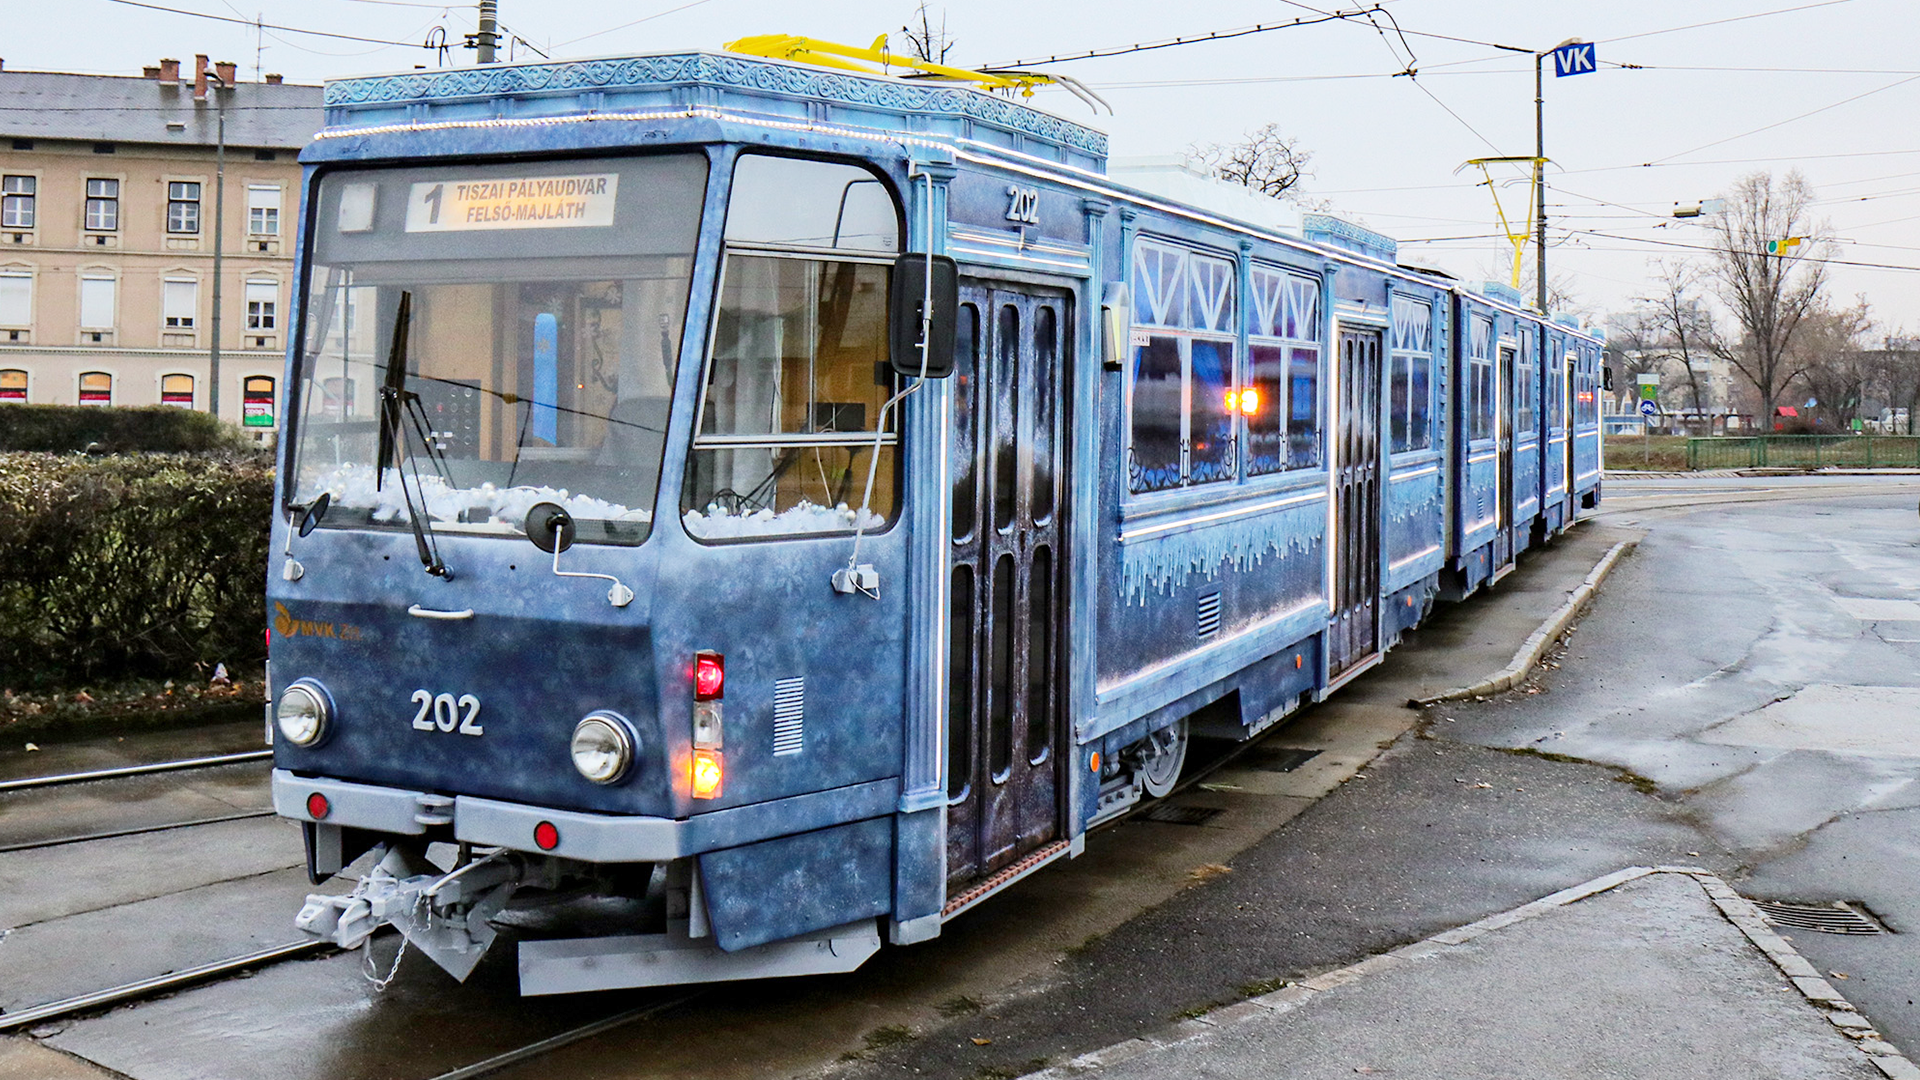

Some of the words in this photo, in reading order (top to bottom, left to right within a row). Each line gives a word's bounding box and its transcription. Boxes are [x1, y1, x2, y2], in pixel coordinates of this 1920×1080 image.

[1556, 45, 1594, 73] VK
[457, 183, 505, 200] TISZAI
[508, 178, 607, 198] PÁLYAUDVAR
[424, 183, 444, 225] 1
[467, 200, 586, 223] FELSŐ-MAJLÁTH
[1005, 185, 1039, 223] 202
[301, 620, 336, 638] MVK
[411, 689, 484, 736] 202
